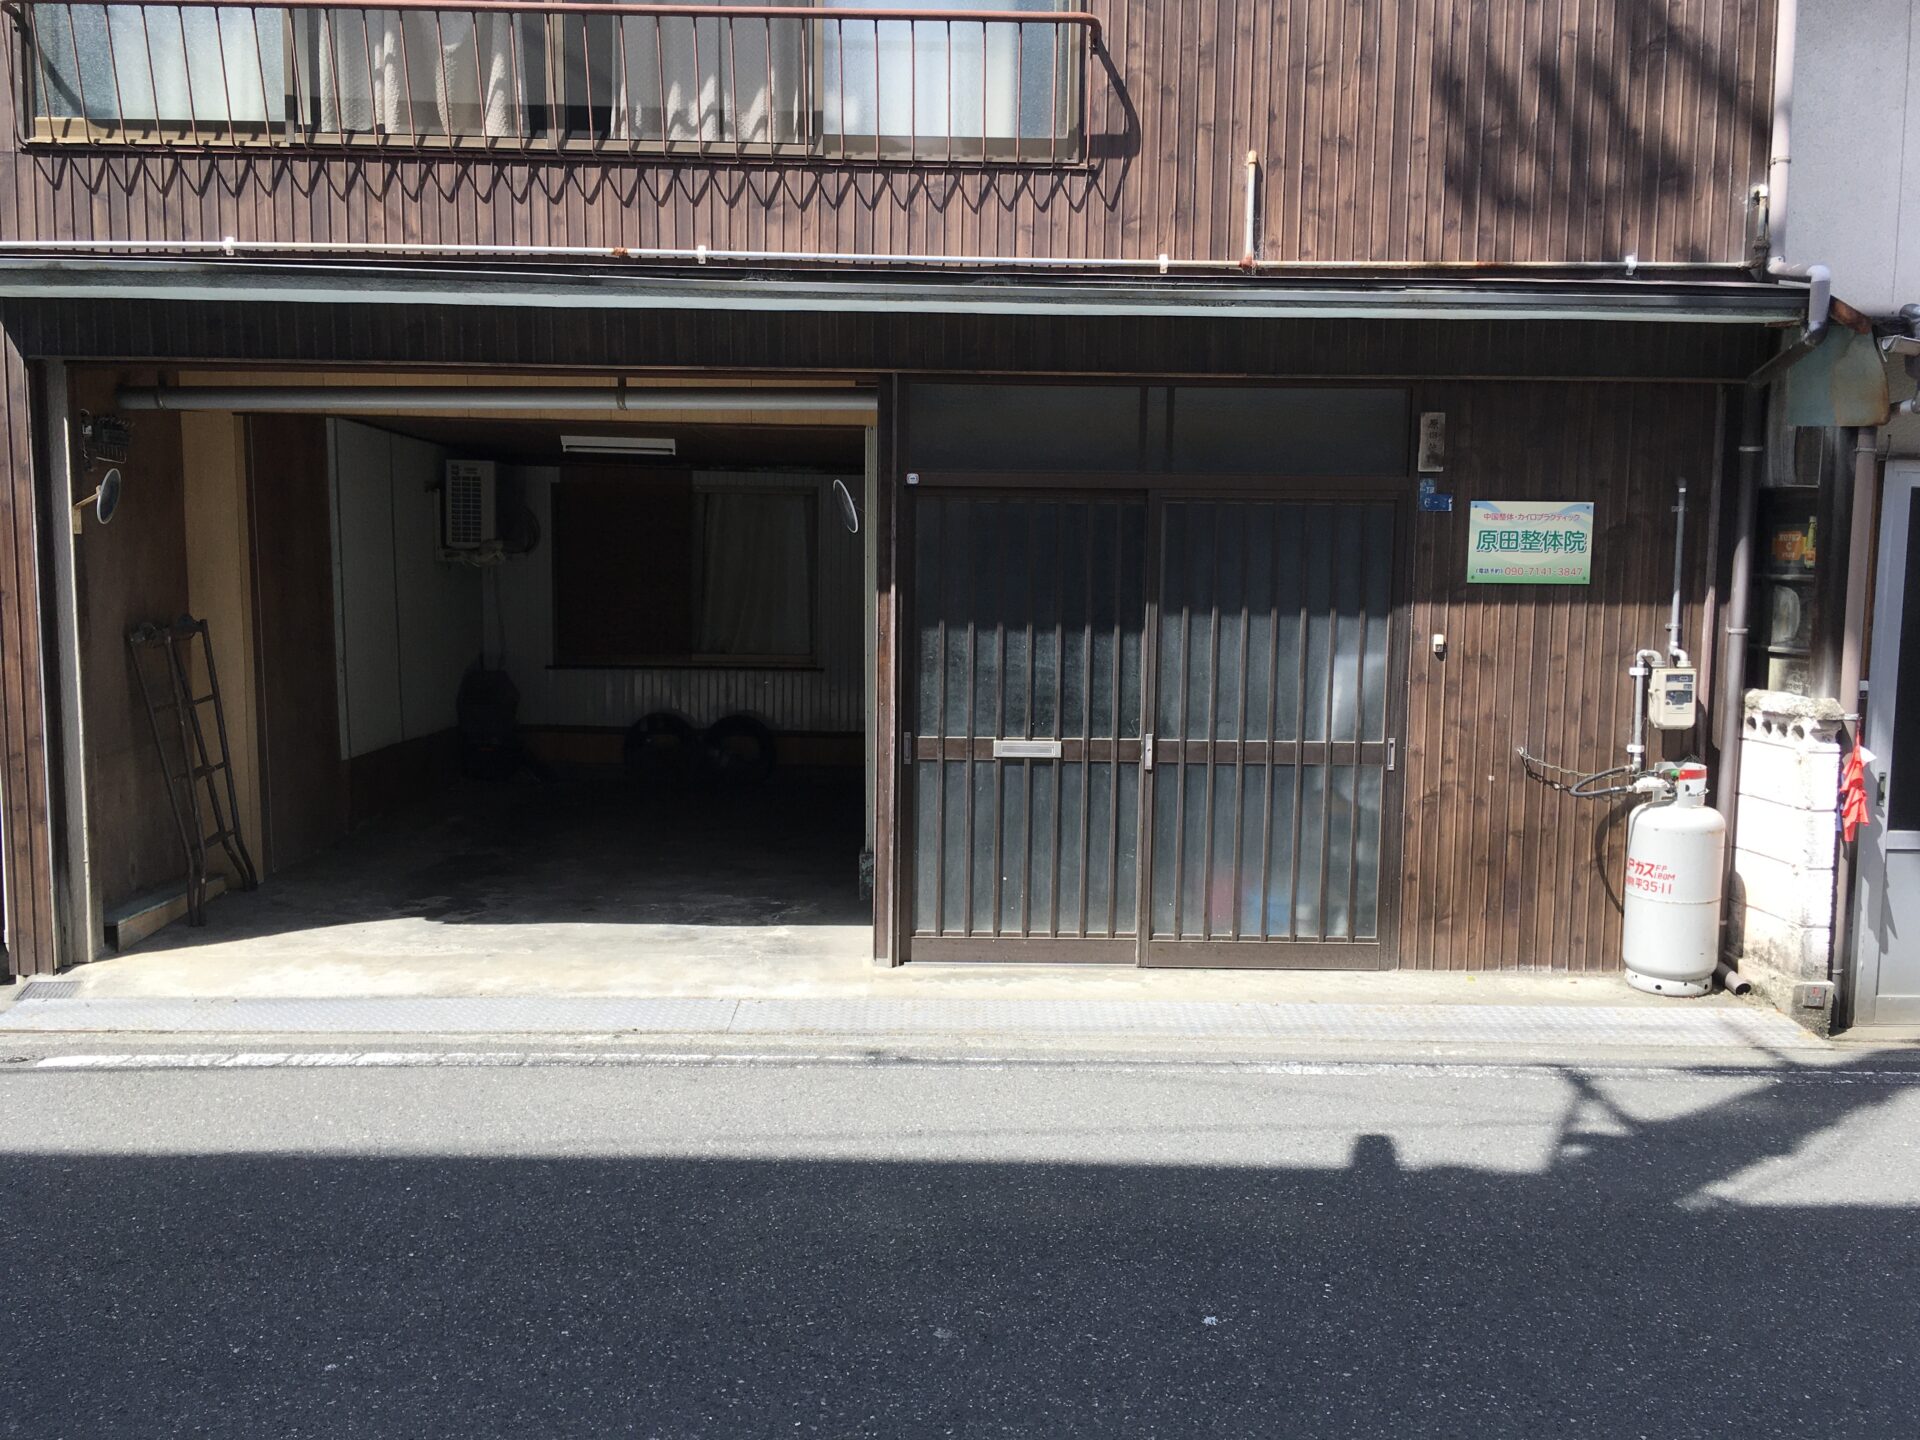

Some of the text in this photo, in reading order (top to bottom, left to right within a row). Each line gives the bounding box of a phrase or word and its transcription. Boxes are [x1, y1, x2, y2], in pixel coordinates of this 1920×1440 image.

[1476, 529, 1588, 554] 原田整体院
[1504, 567, 1583, 577] 090-7141-3847
